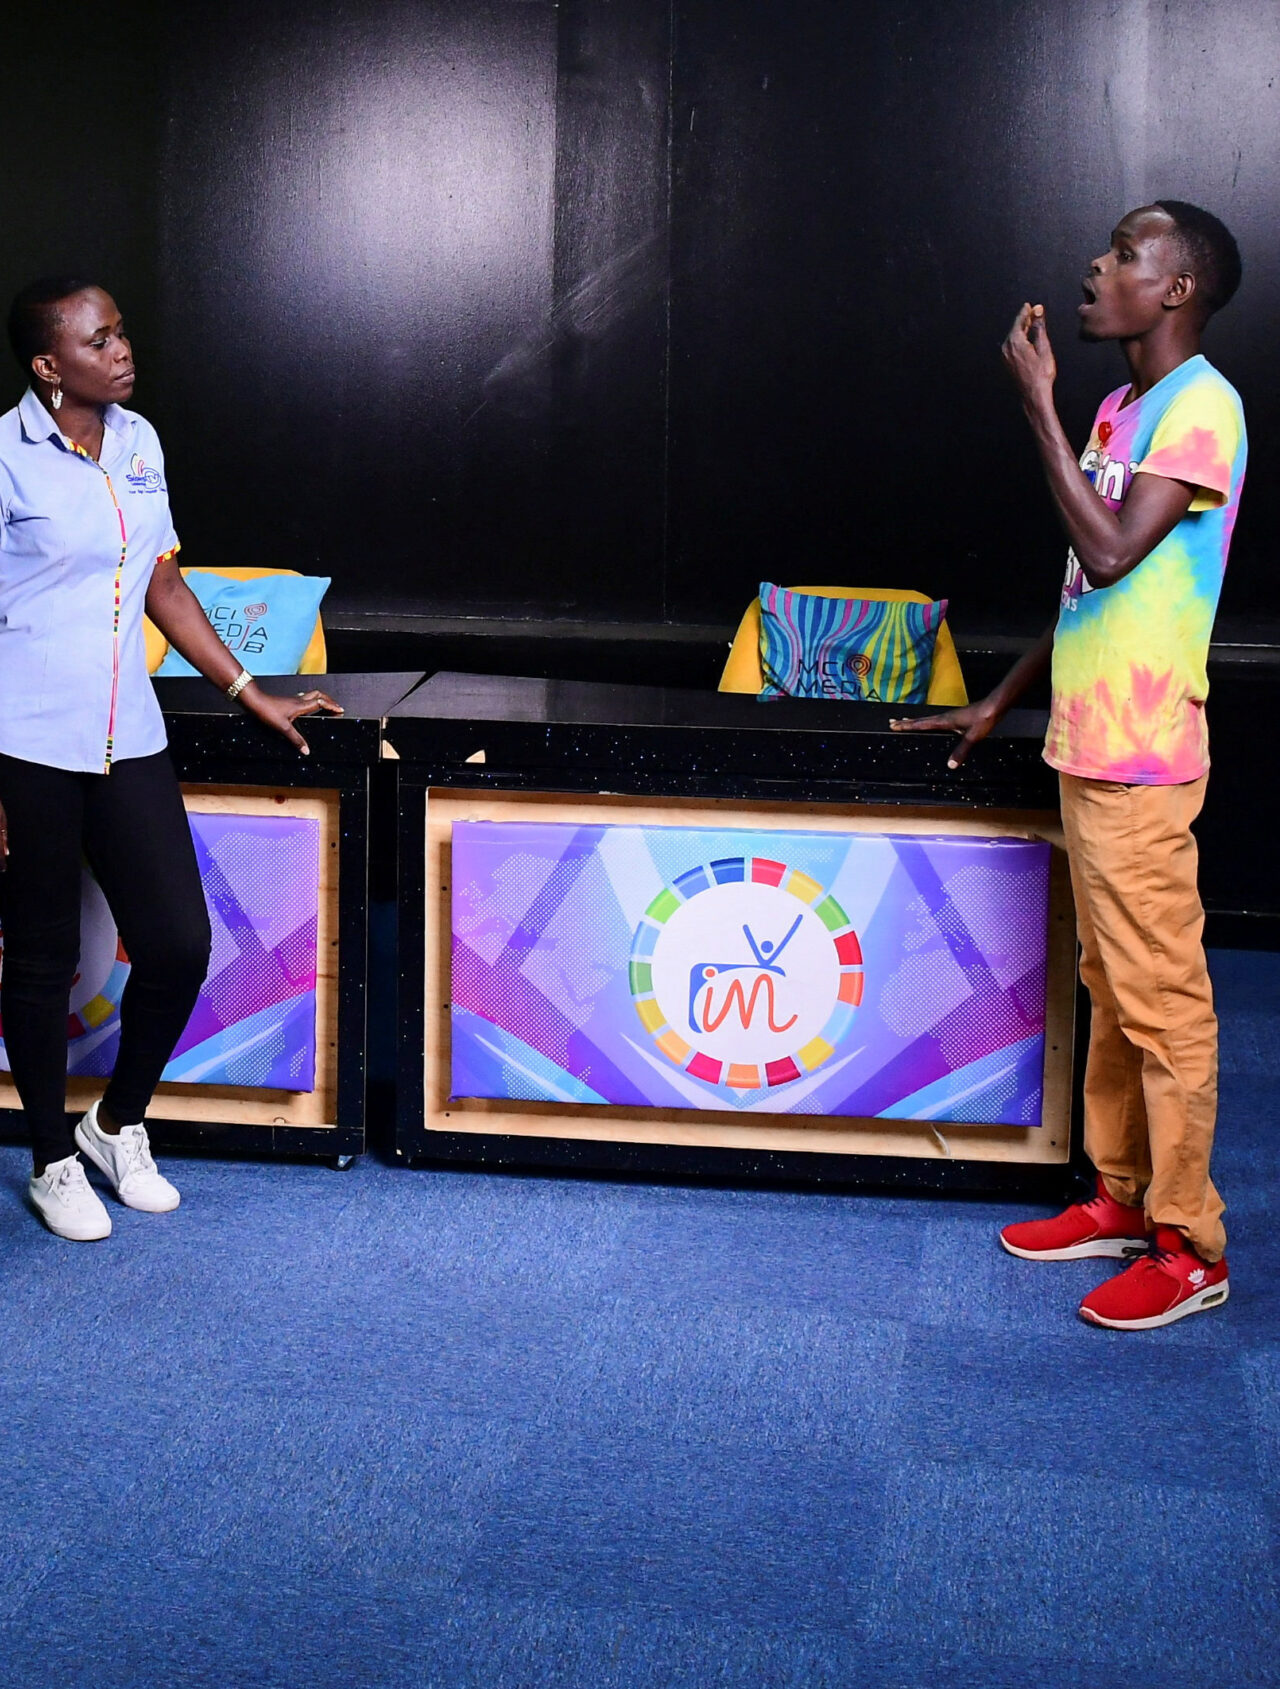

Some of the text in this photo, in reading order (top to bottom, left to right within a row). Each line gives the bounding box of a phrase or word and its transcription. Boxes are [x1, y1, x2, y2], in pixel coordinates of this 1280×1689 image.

[212, 623, 269, 641] EDIA
[222, 639, 265, 654] UB
[798, 659, 845, 677] MCI
[796, 678, 883, 702] MEDIA
